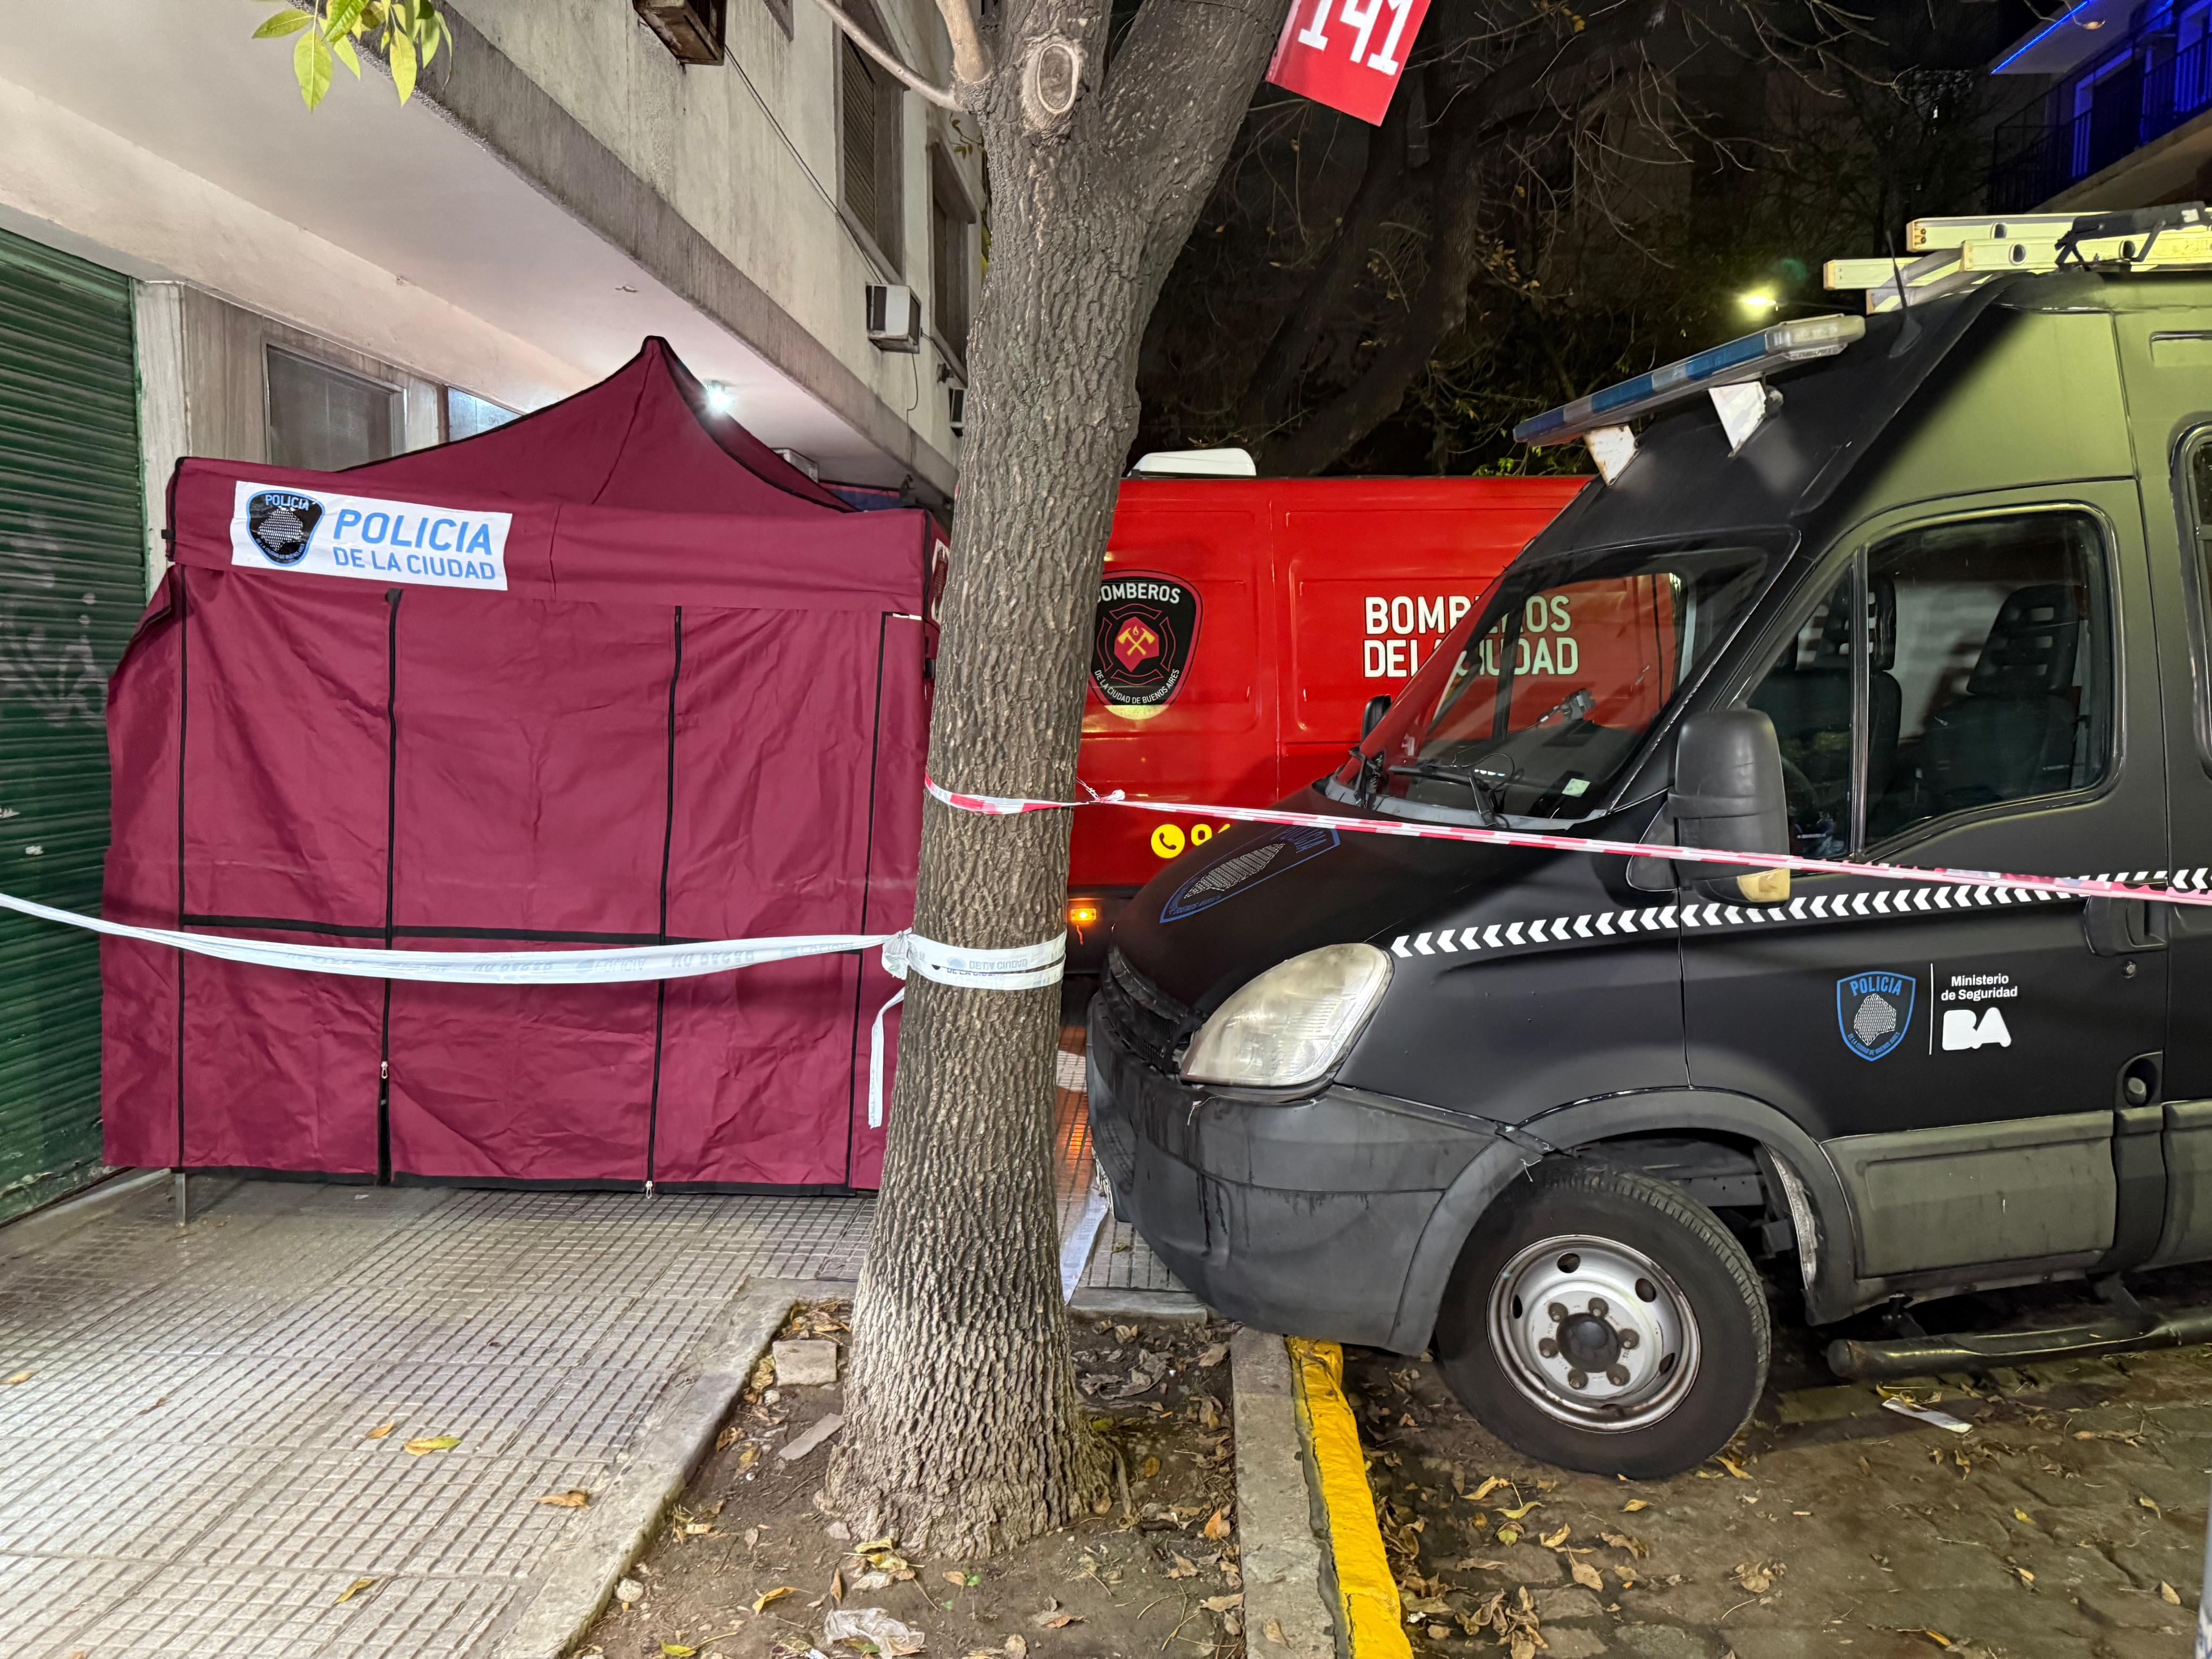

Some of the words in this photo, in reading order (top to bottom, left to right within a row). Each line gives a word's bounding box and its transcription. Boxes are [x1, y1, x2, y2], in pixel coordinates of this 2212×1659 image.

[265, 495, 309, 510] POLICIA
[333, 509, 492, 555] POLICIA
[333, 547, 365, 568] DE
[372, 550, 401, 572] LA
[407, 554, 496, 580] CIUDAD
[1097, 582, 1181, 604] OMBEROS
[1365, 595, 1572, 635] BOMBOS
[1094, 669, 1104, 681] DE
[1100, 678, 1108, 690] LA
[1107, 688, 1130, 703] CIUDAD
[1142, 688, 1168, 704] BUENOS
[1166, 668, 1180, 690] AIRES
[1850, 977, 1903, 996] POLICIA
[1951, 973, 2009, 987] Ministerio
[1941, 990, 1956, 1001] de
[1958, 986, 2018, 1002] Seguridad
[1942, 1007, 2012, 1051] BA
